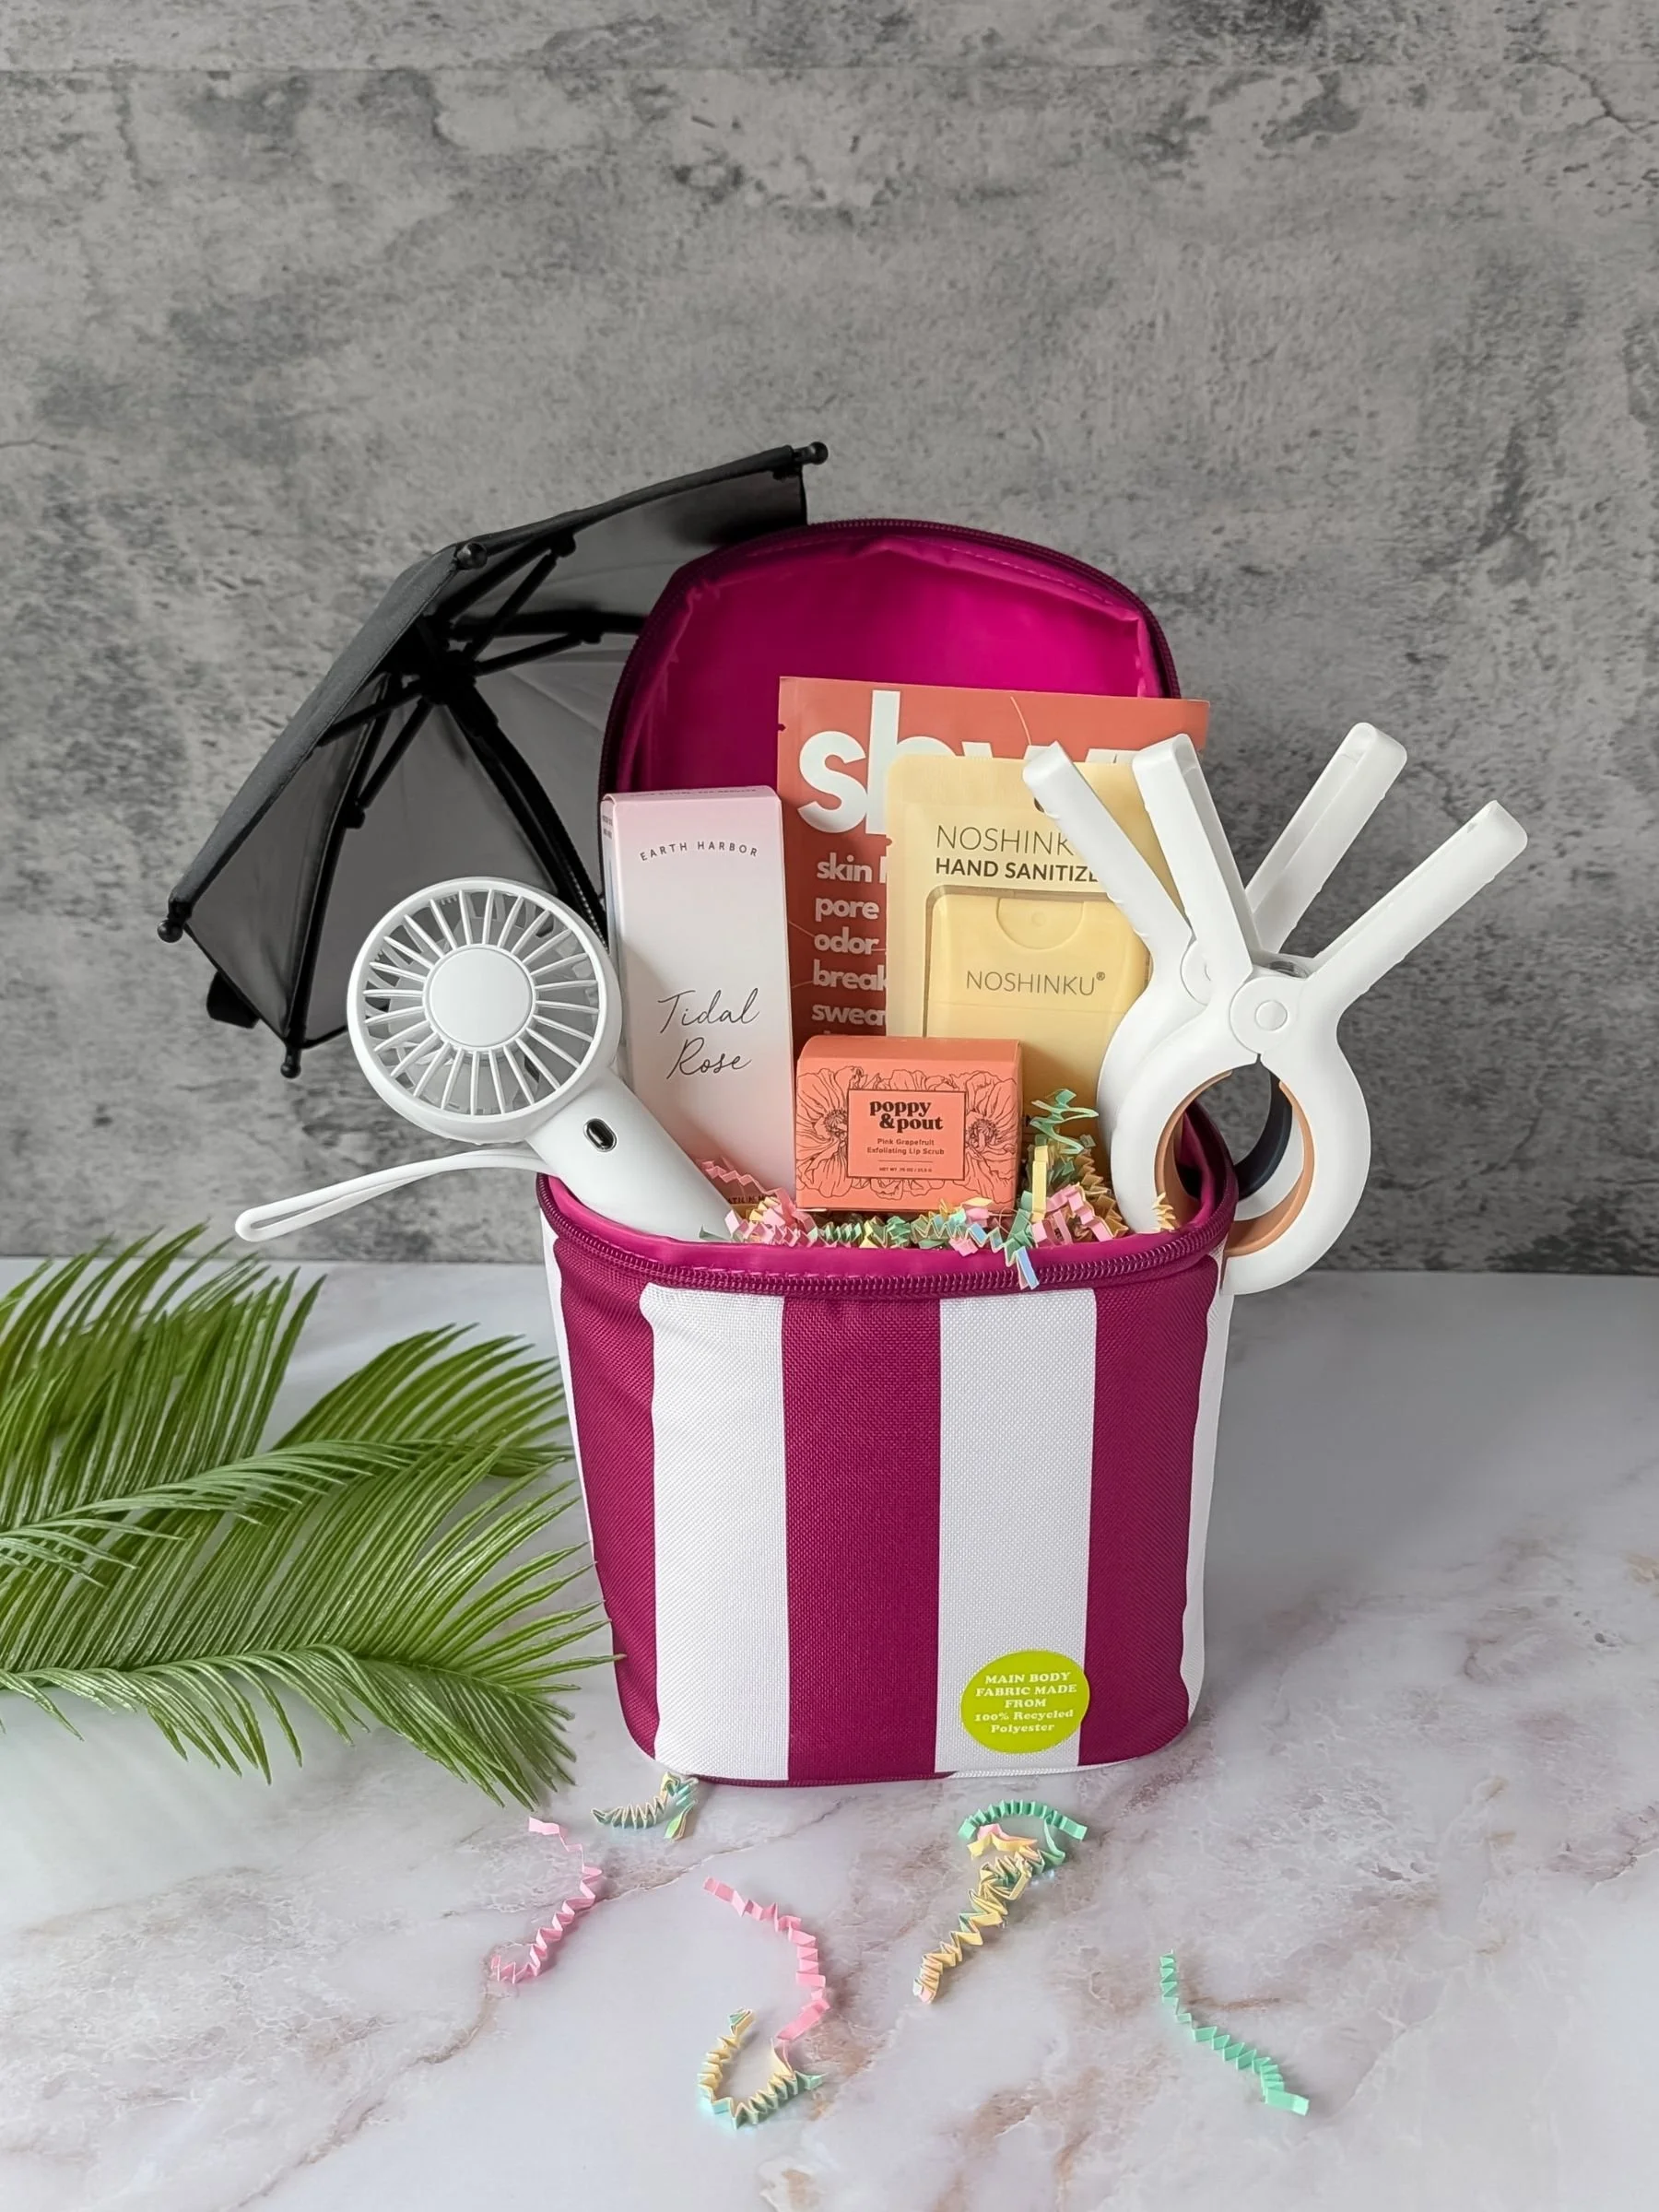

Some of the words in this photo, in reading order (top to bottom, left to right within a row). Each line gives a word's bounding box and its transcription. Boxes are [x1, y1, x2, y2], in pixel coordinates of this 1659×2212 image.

[936, 824, 1075, 856] NOSHINK
[639, 841, 688, 862] EARTH
[697, 841, 758, 857] HARBOR
[817, 852, 873, 883] skin
[935, 857, 999, 877] HAND
[815, 897, 880, 923] pore
[814, 925, 880, 955] odor
[657, 987, 759, 1034] Tidal
[665, 1036, 753, 1080] Rose
[869, 1100, 932, 1118] poppy
[866, 1147, 907, 1156] Exfoliating
[909, 1147, 921, 1156] Lip
[923, 1147, 945, 1156] Scrub
[877, 1137, 894, 1146] Pink
[896, 1138, 935, 1147] Grapefruit
[984, 1674, 1025, 1685] MAIN
[1029, 1671, 1071, 1683] BODY
[975, 1686, 1030, 1697] FABRIC
[1034, 1684, 1077, 1695] MADE
[1005, 1698, 1047, 1709] FROM
[974, 1712, 1009, 1722] 100%
[1013, 1709, 1075, 1722] Recycled
[991, 1724, 1055, 1735] Polyester
